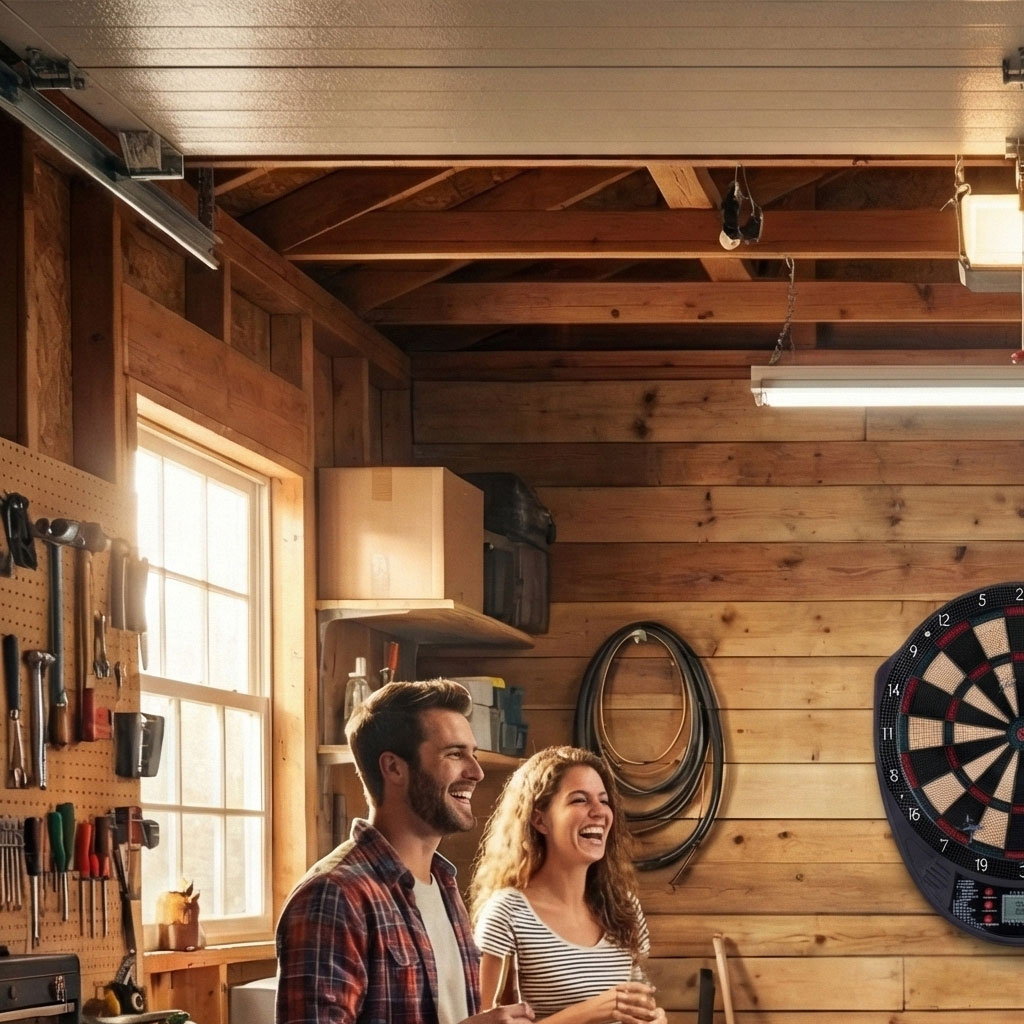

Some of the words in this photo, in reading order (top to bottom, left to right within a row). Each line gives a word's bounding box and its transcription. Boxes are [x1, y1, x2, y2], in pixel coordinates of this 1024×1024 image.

[978, 593, 987, 607] 5
[938, 613, 950, 627] 12
[909, 644, 918, 658] 9
[887, 683, 900, 697] 14
[882, 727, 893, 741] 11
[889, 768, 899, 783] 8
[908, 807, 921, 821] 16
[939, 837, 949, 853] 7
[975, 858, 988, 872] 19
